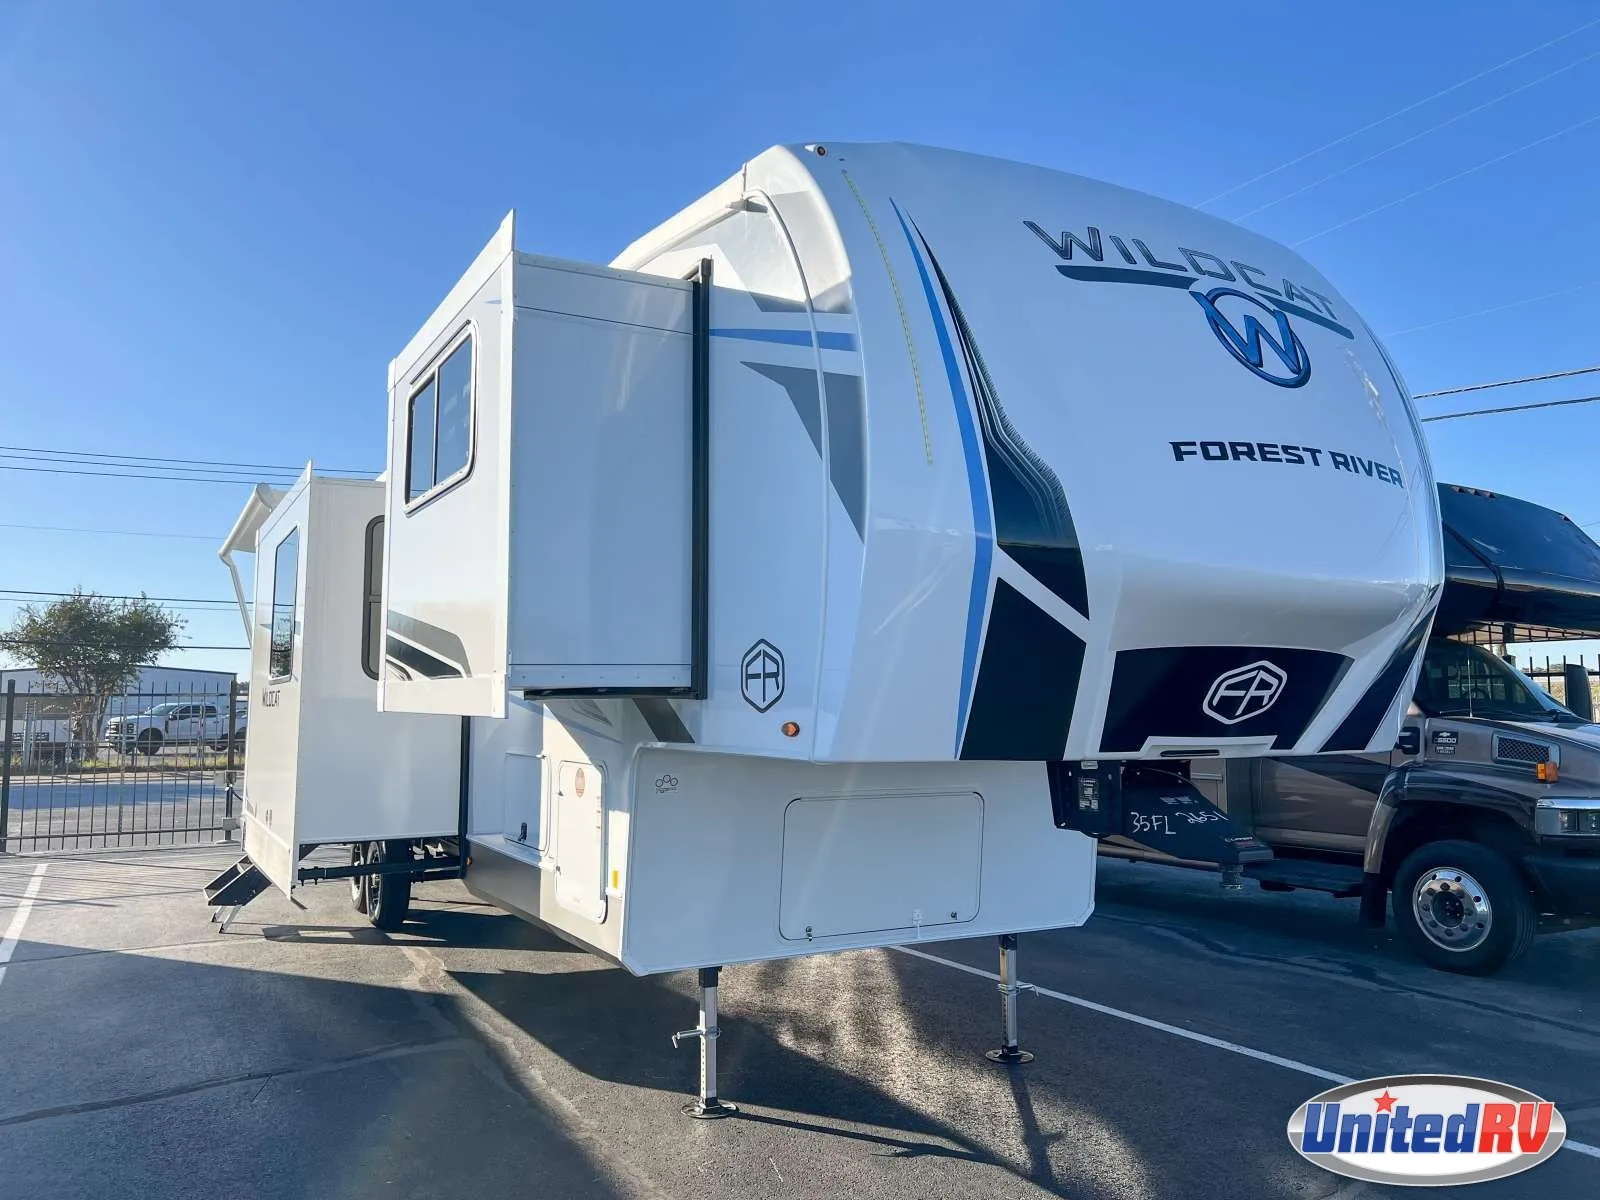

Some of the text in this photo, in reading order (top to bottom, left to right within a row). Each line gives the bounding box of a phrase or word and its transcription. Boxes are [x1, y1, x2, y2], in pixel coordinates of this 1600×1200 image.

[1022, 219, 1339, 320] WILDCAT
[1168, 440, 1404, 489] FOREST RIVER
[1130, 811, 1177, 835] 35FL
